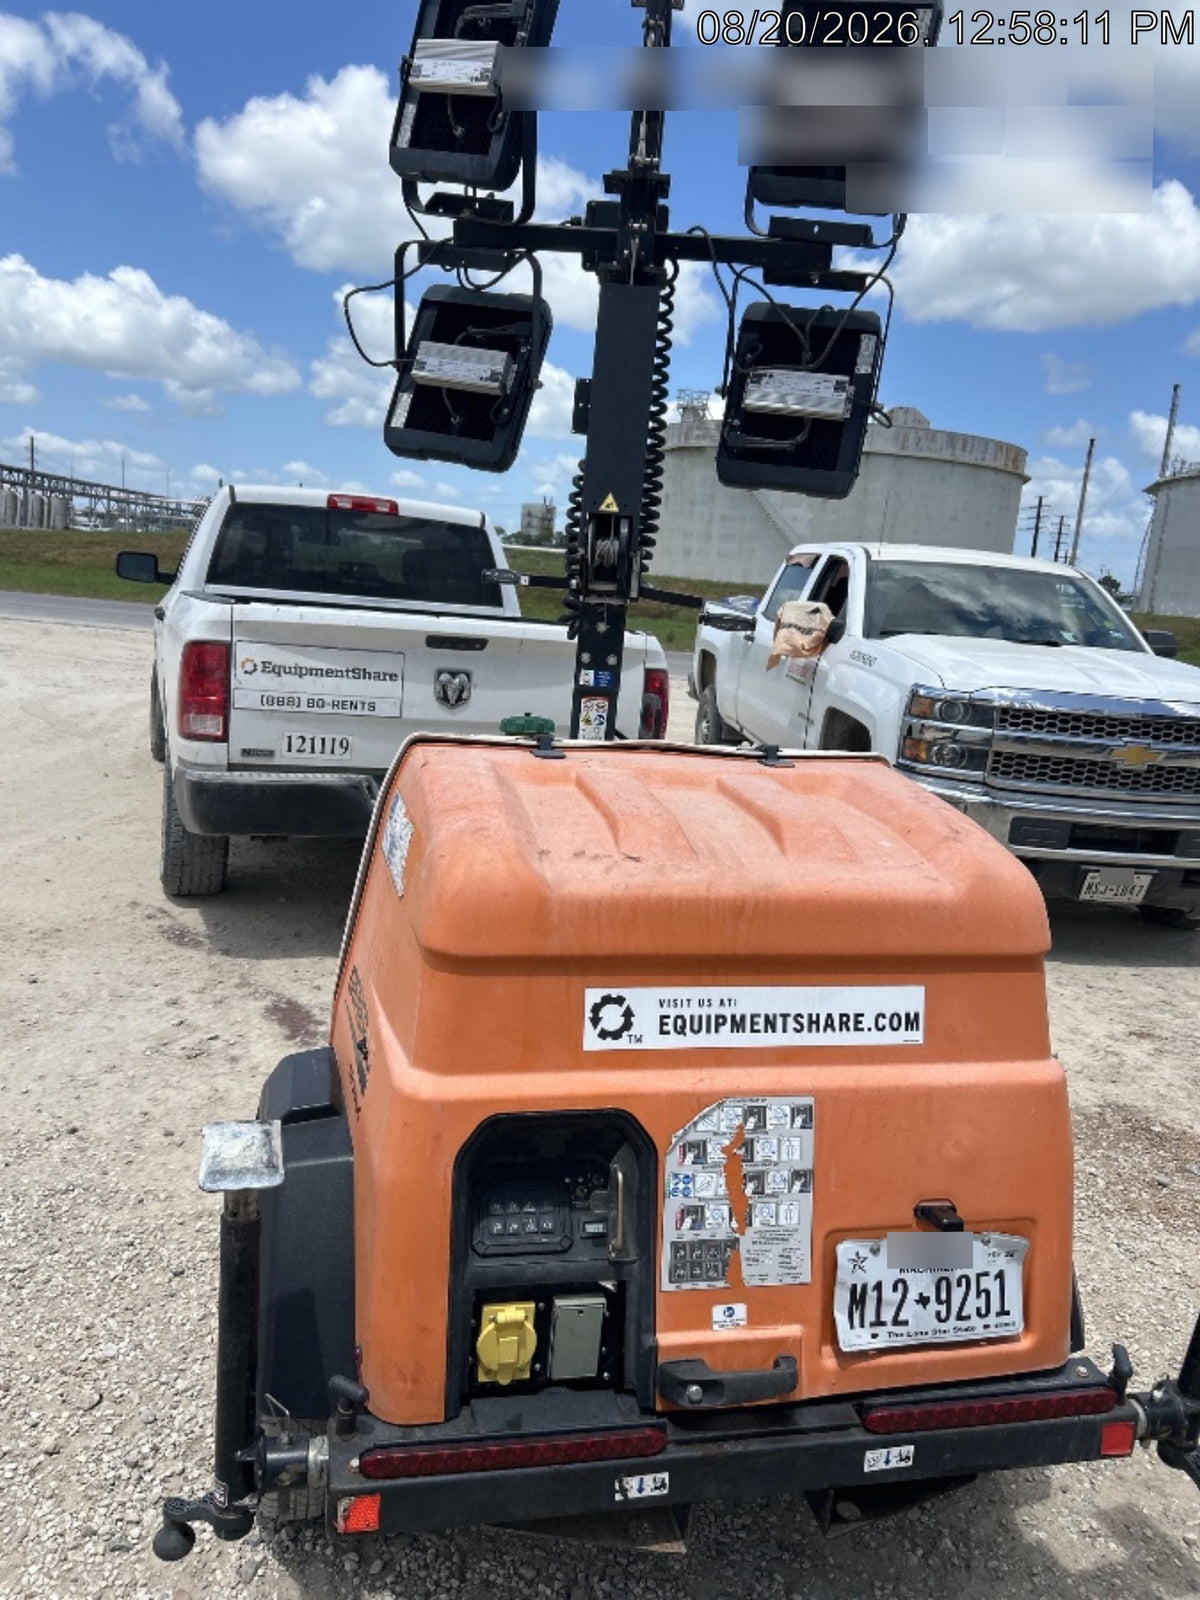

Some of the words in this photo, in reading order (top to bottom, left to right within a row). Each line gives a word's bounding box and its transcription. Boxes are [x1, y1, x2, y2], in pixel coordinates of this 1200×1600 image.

[260, 660, 399, 682] EquipmentShare
[286, 735, 350, 757] 121119
[659, 998, 693, 1009] VISIT
[698, 998, 713, 1008] US
[658, 1011, 921, 1037] EQUIPMENTSHARE.COM
[849, 1277, 909, 1330] M12
[935, 1269, 1011, 1324] 9251
